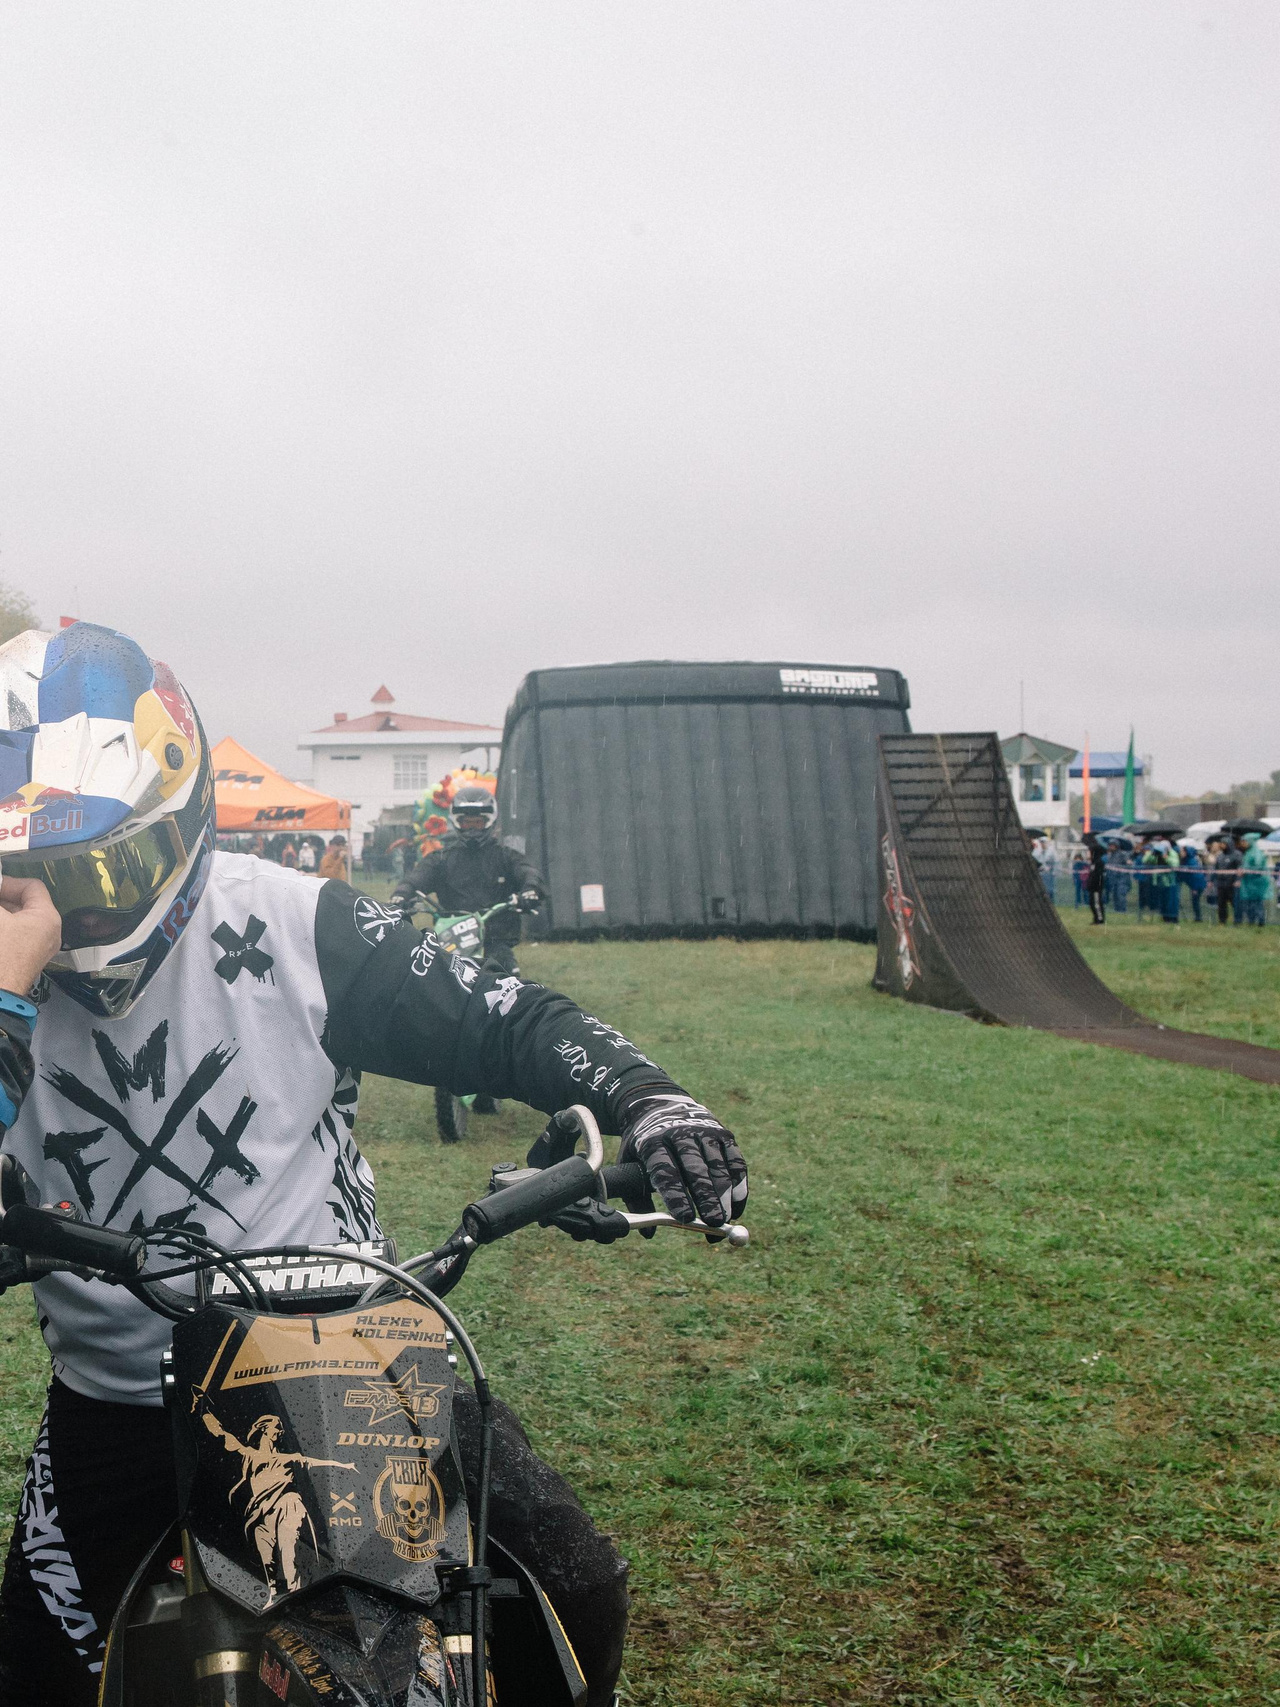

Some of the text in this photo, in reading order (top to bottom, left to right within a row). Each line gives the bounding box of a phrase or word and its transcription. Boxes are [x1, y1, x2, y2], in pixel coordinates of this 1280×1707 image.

[215, 769, 265, 784] TM
[254, 805, 306, 821] KTM
[31, 809, 84, 836] Bull
[451, 917, 479, 936] 102
[355, 1315, 424, 1328] ALEXEY
[336, 1432, 440, 1450] DUNLOP
[392, 1460, 428, 1486] СВОЯ
[329, 1517, 362, 1527] RMG
